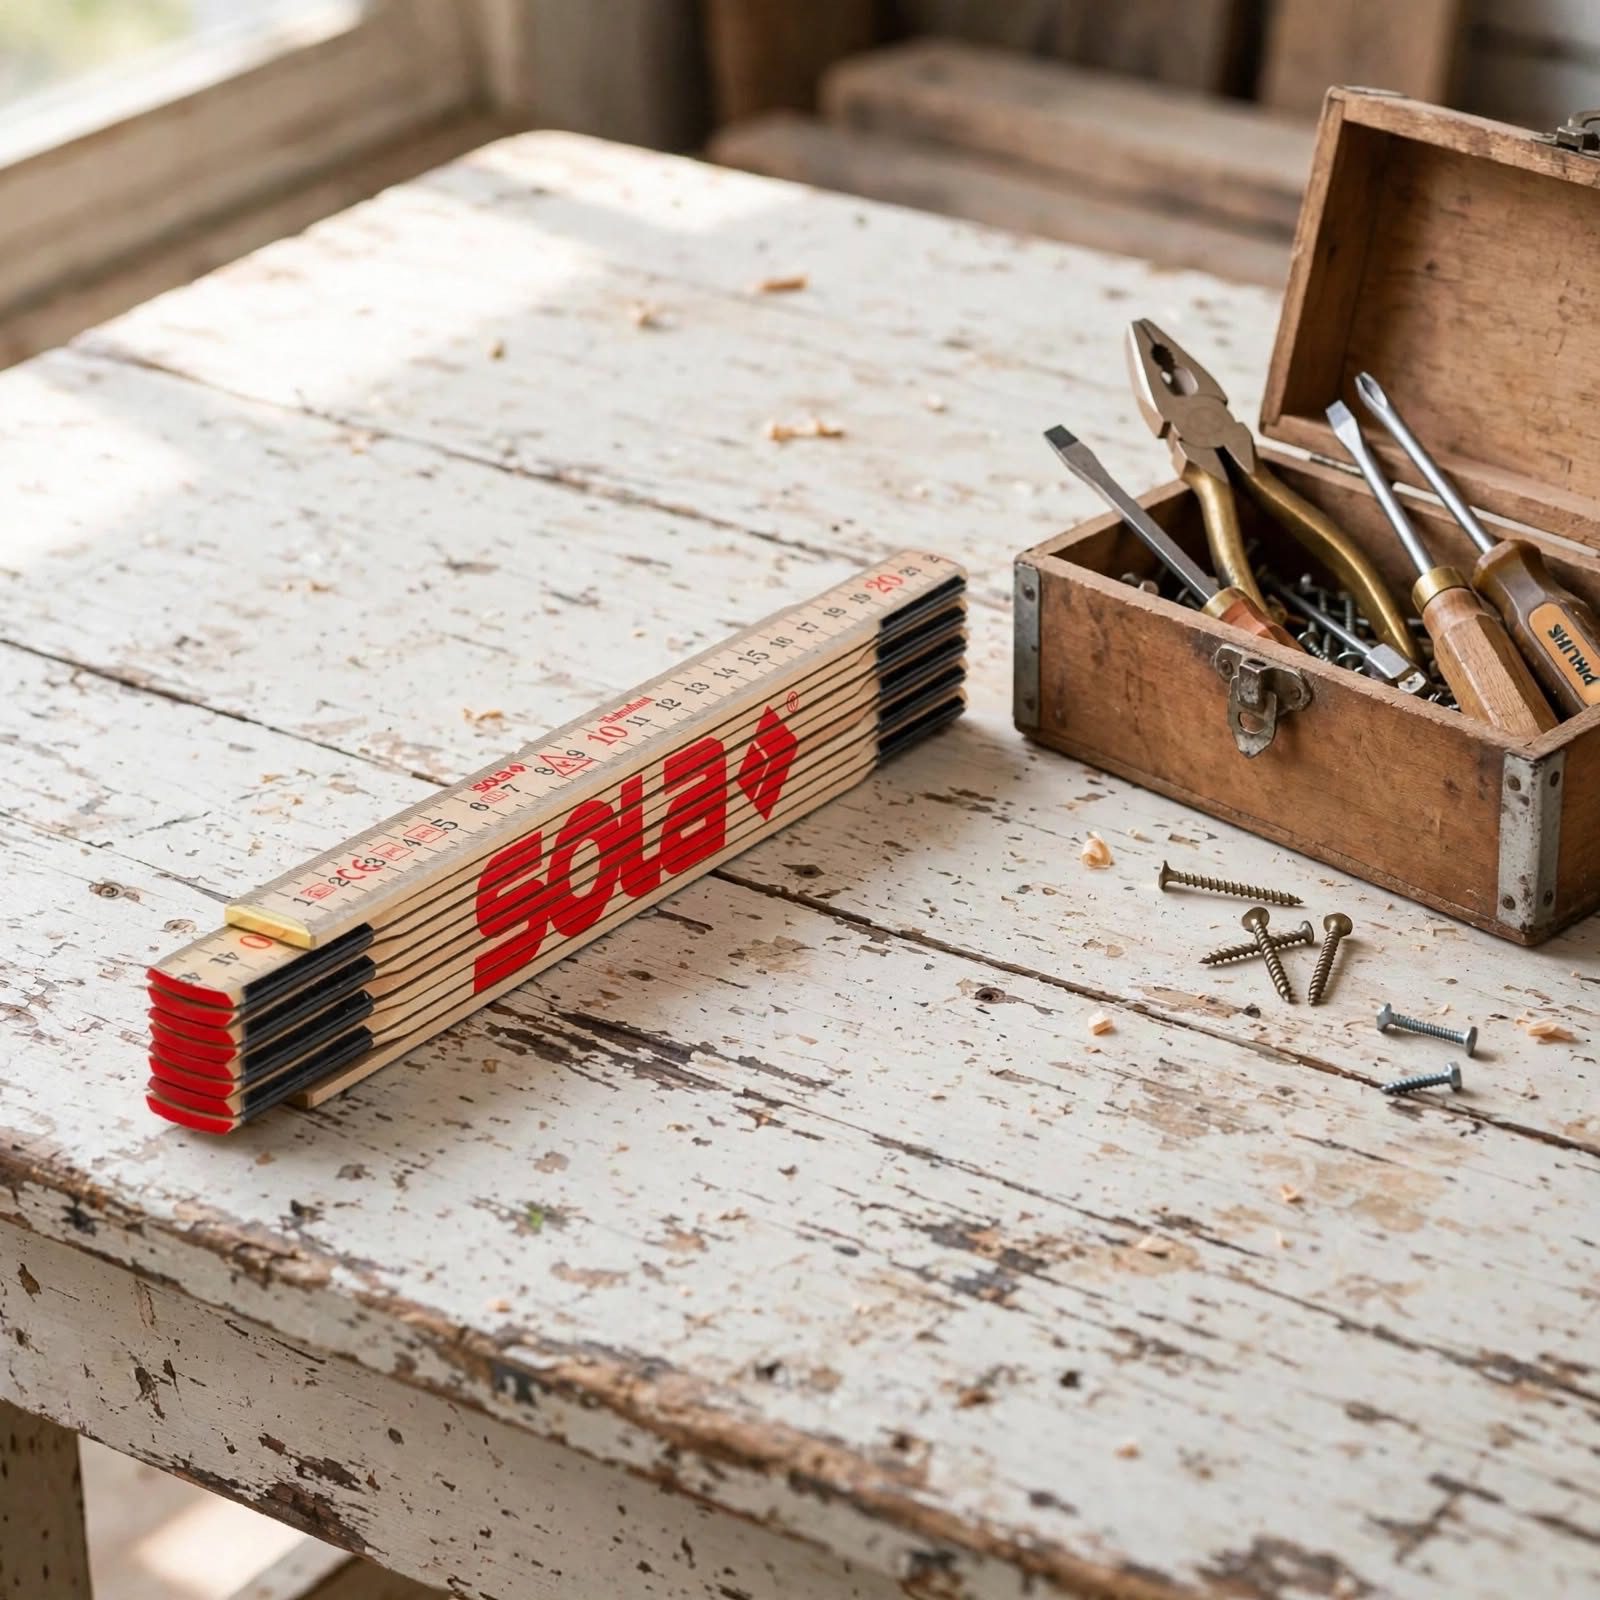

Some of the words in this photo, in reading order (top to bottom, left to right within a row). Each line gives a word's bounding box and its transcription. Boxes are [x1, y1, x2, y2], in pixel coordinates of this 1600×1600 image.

[402, 838, 422, 848] 4
[431, 818, 459, 831] 5
[500, 783, 521, 793] 7
[534, 766, 555, 776] 8
[566, 749, 586, 759] 9
[587, 725, 628, 746] 10
[626, 715, 651, 727] 11
[655, 698, 682, 711] 12
[684, 682, 710, 695] 13
[713, 667, 739, 679] 14
[738, 650, 770, 666] 15
[796, 622, 819, 634] 17
[865, 573, 904, 593] 20
